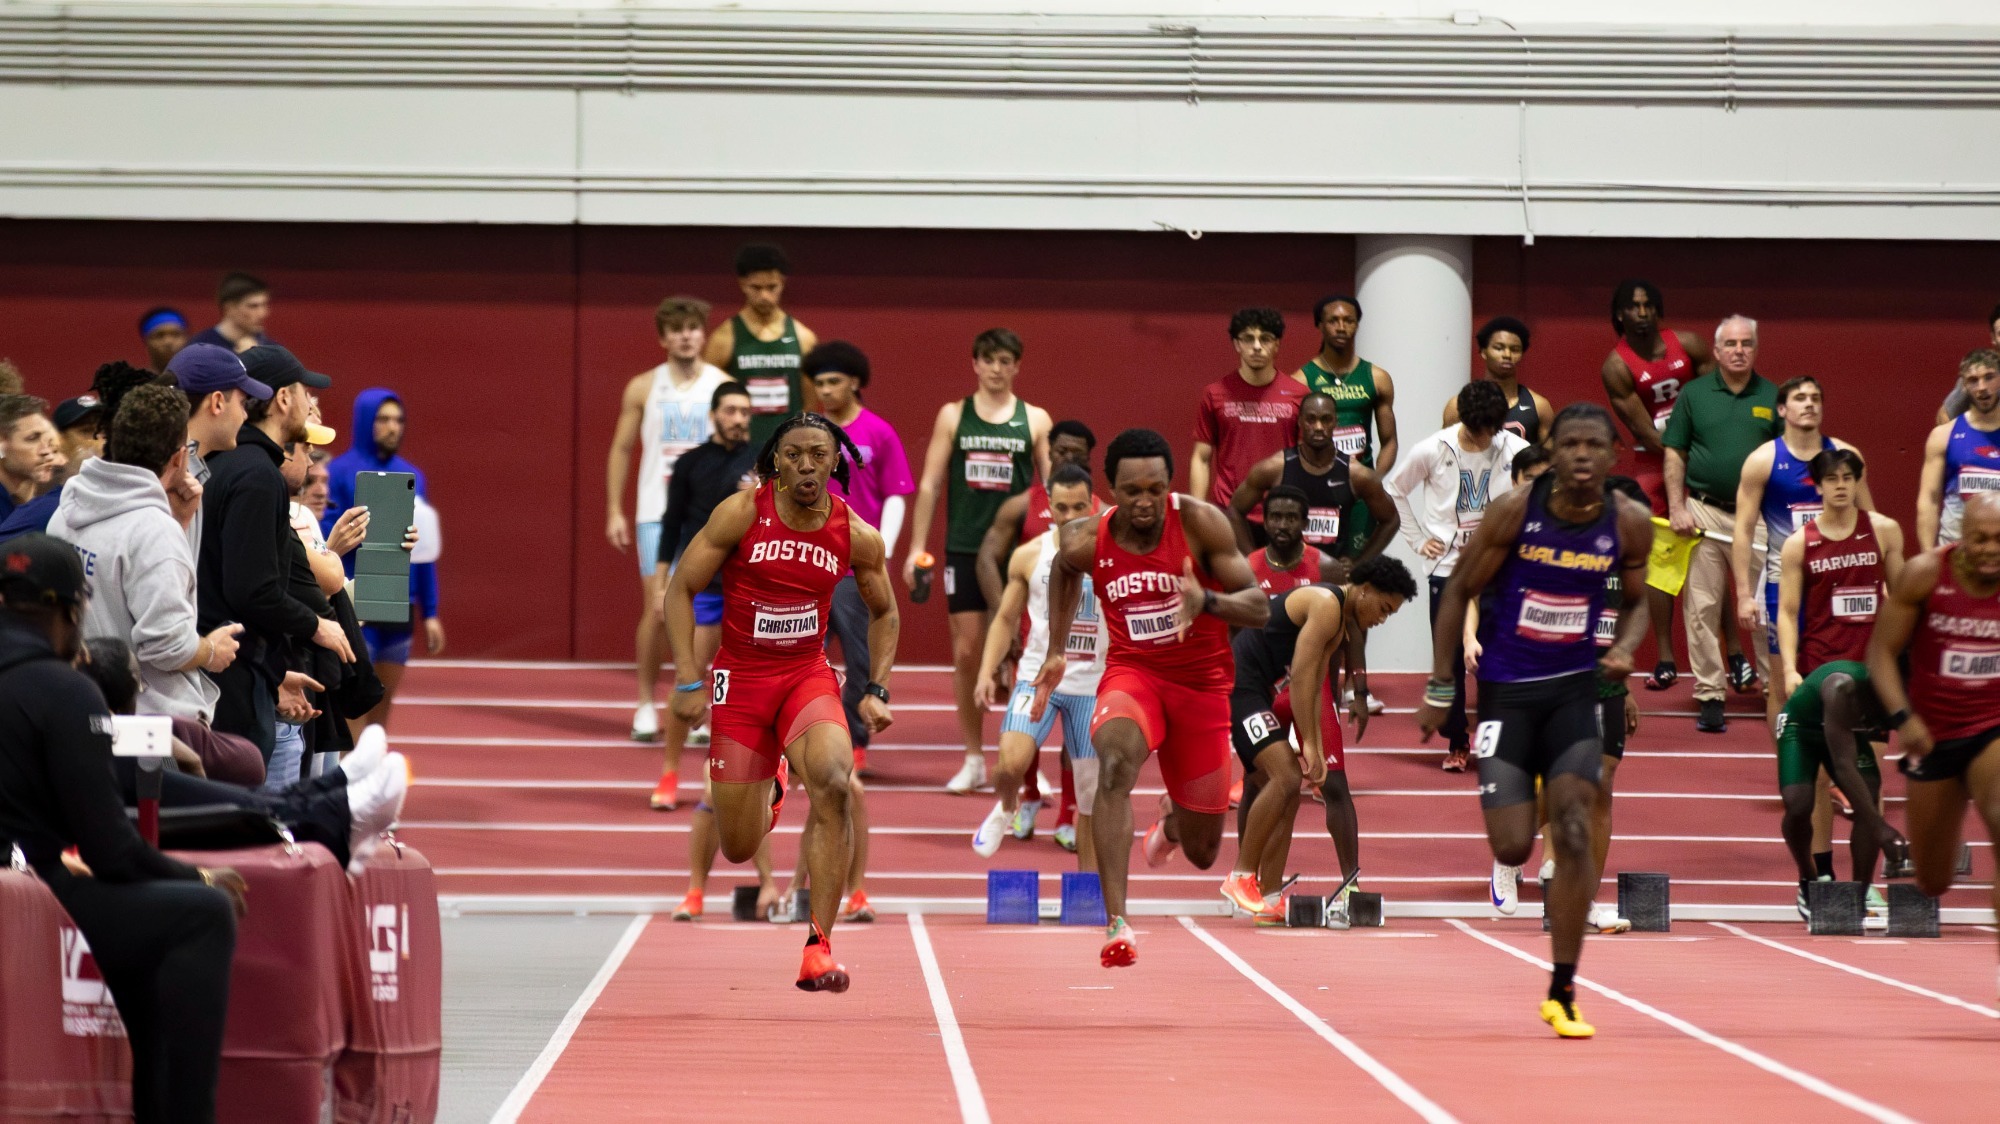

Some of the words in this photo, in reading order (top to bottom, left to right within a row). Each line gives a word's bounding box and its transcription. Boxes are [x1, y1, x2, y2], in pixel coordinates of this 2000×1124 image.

[749, 540, 838, 575] BOSTON
[1809, 552, 1877, 573] HARVARD
[1842, 596, 1873, 612] TONG
[758, 615, 816, 633] CHRISTIAN
[1928, 613, 2000, 639] HARVA
[715, 672, 725, 702] 8
[1020, 695, 1031, 711] 7
[1249, 717, 1263, 739] 6
